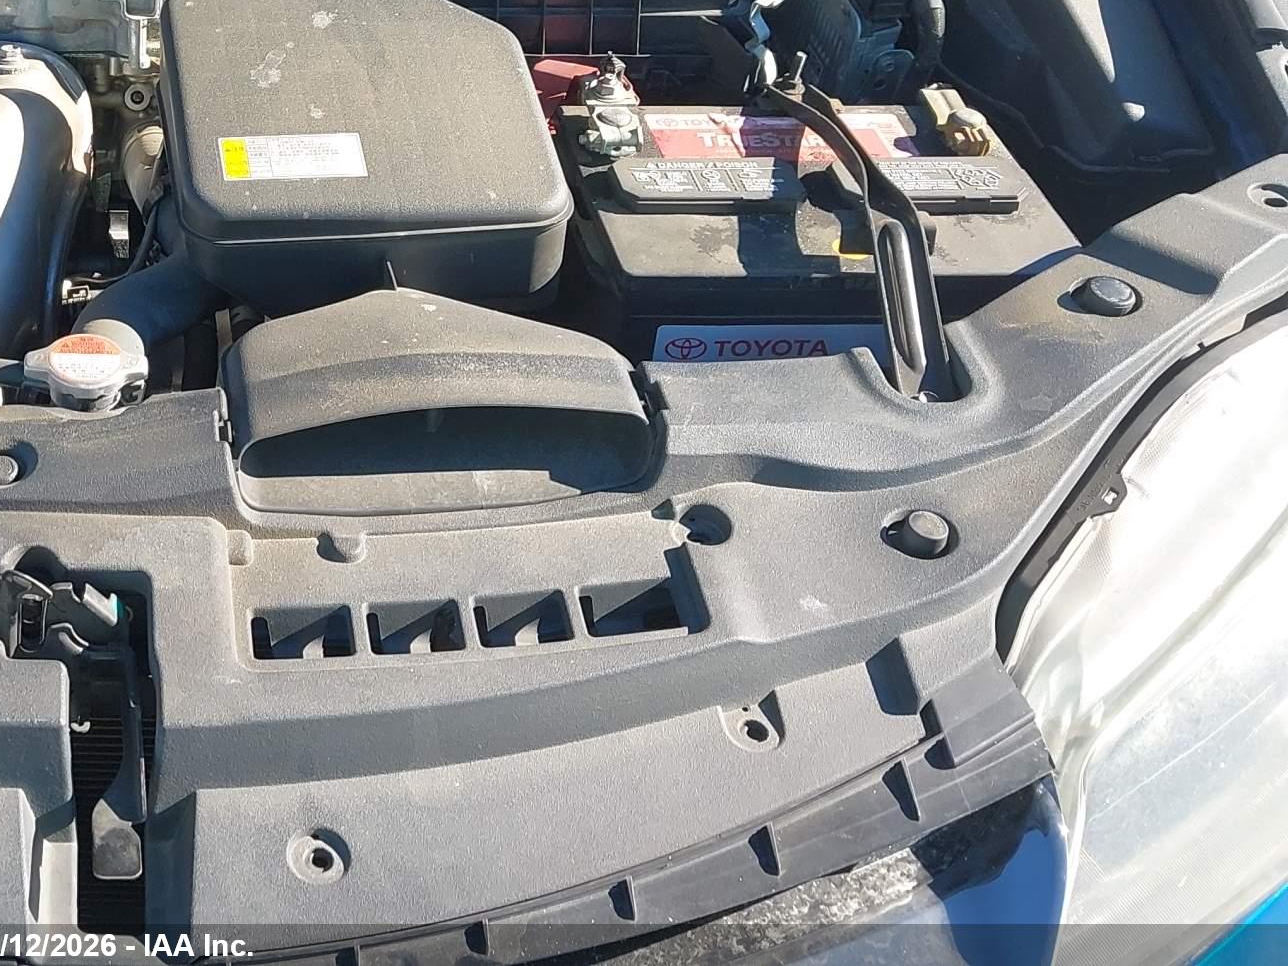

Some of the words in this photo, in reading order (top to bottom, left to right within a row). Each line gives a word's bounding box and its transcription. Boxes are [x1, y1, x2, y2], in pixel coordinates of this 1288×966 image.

[658, 161, 707, 170] DANGER
[715, 160, 759, 169] POISON
[714, 339, 829, 357] TOYOTA
